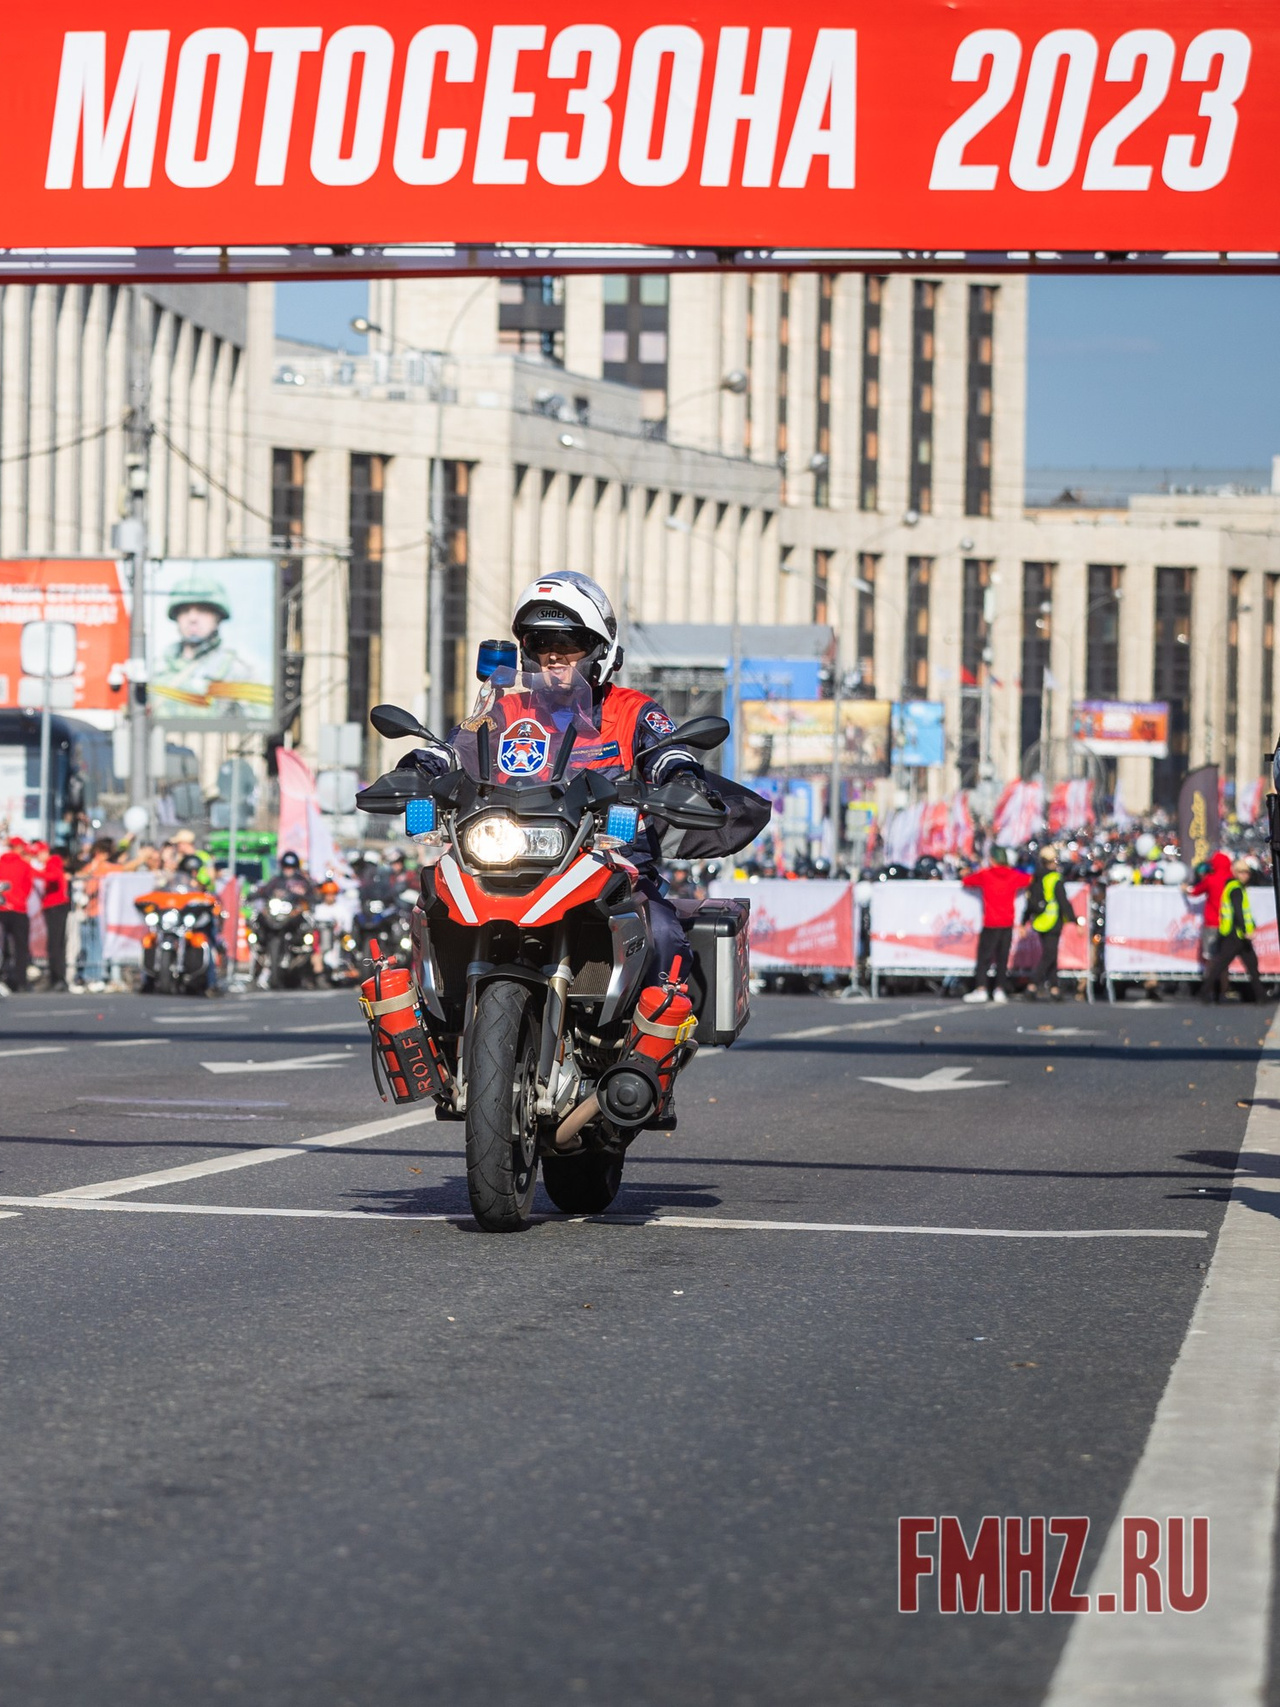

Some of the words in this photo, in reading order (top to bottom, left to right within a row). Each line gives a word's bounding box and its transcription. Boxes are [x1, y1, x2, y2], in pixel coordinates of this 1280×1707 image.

[43, 24, 858, 192] МОТОСЕЗОНА
[927, 28, 1254, 193] 2023
[401, 1036, 435, 1093] ROLF
